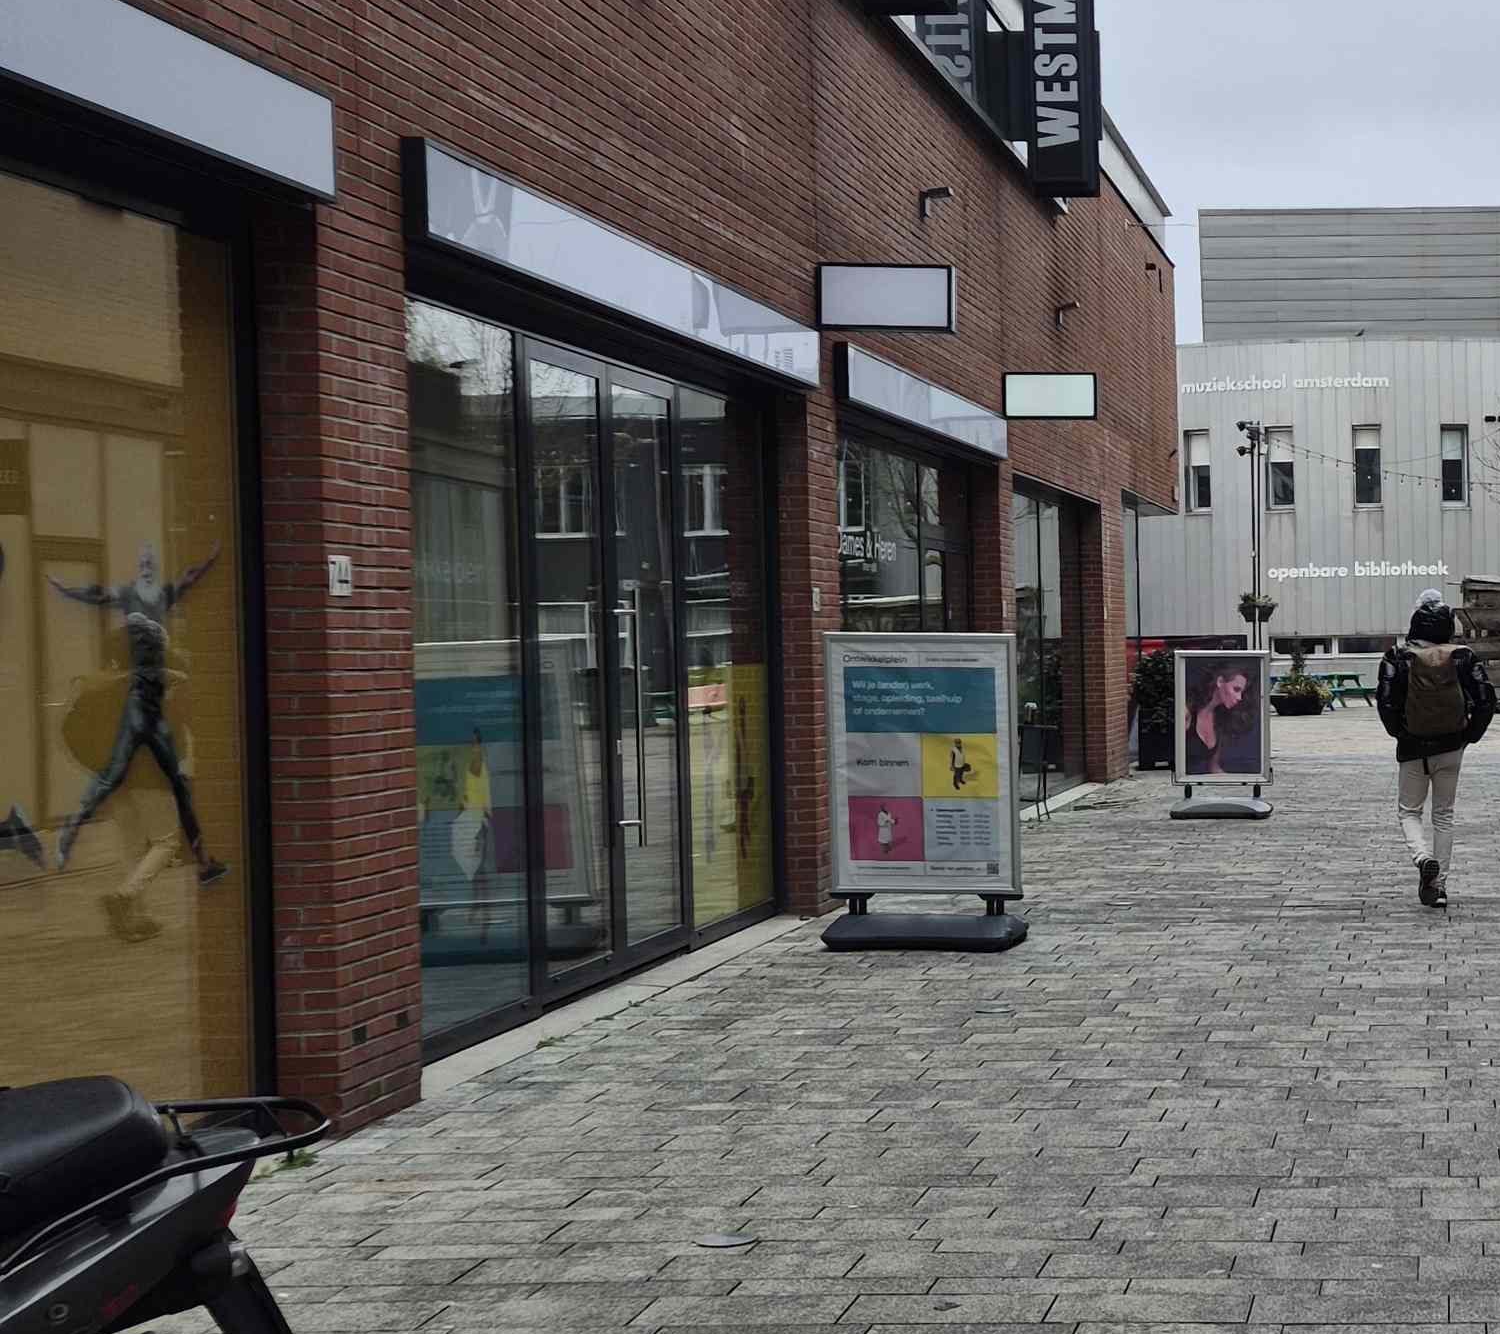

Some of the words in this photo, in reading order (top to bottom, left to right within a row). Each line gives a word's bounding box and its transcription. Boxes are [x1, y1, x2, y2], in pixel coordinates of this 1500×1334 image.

[1181, 374, 1287, 394] muziekschool
[1293, 372, 1390, 389] amsterdam
[865, 530, 873, 559] &
[1267, 563, 1349, 582] openbare
[1354, 560, 1449, 577] bibliotheek
[856, 758, 877, 767] Kom
[879, 758, 910, 767] binnen
